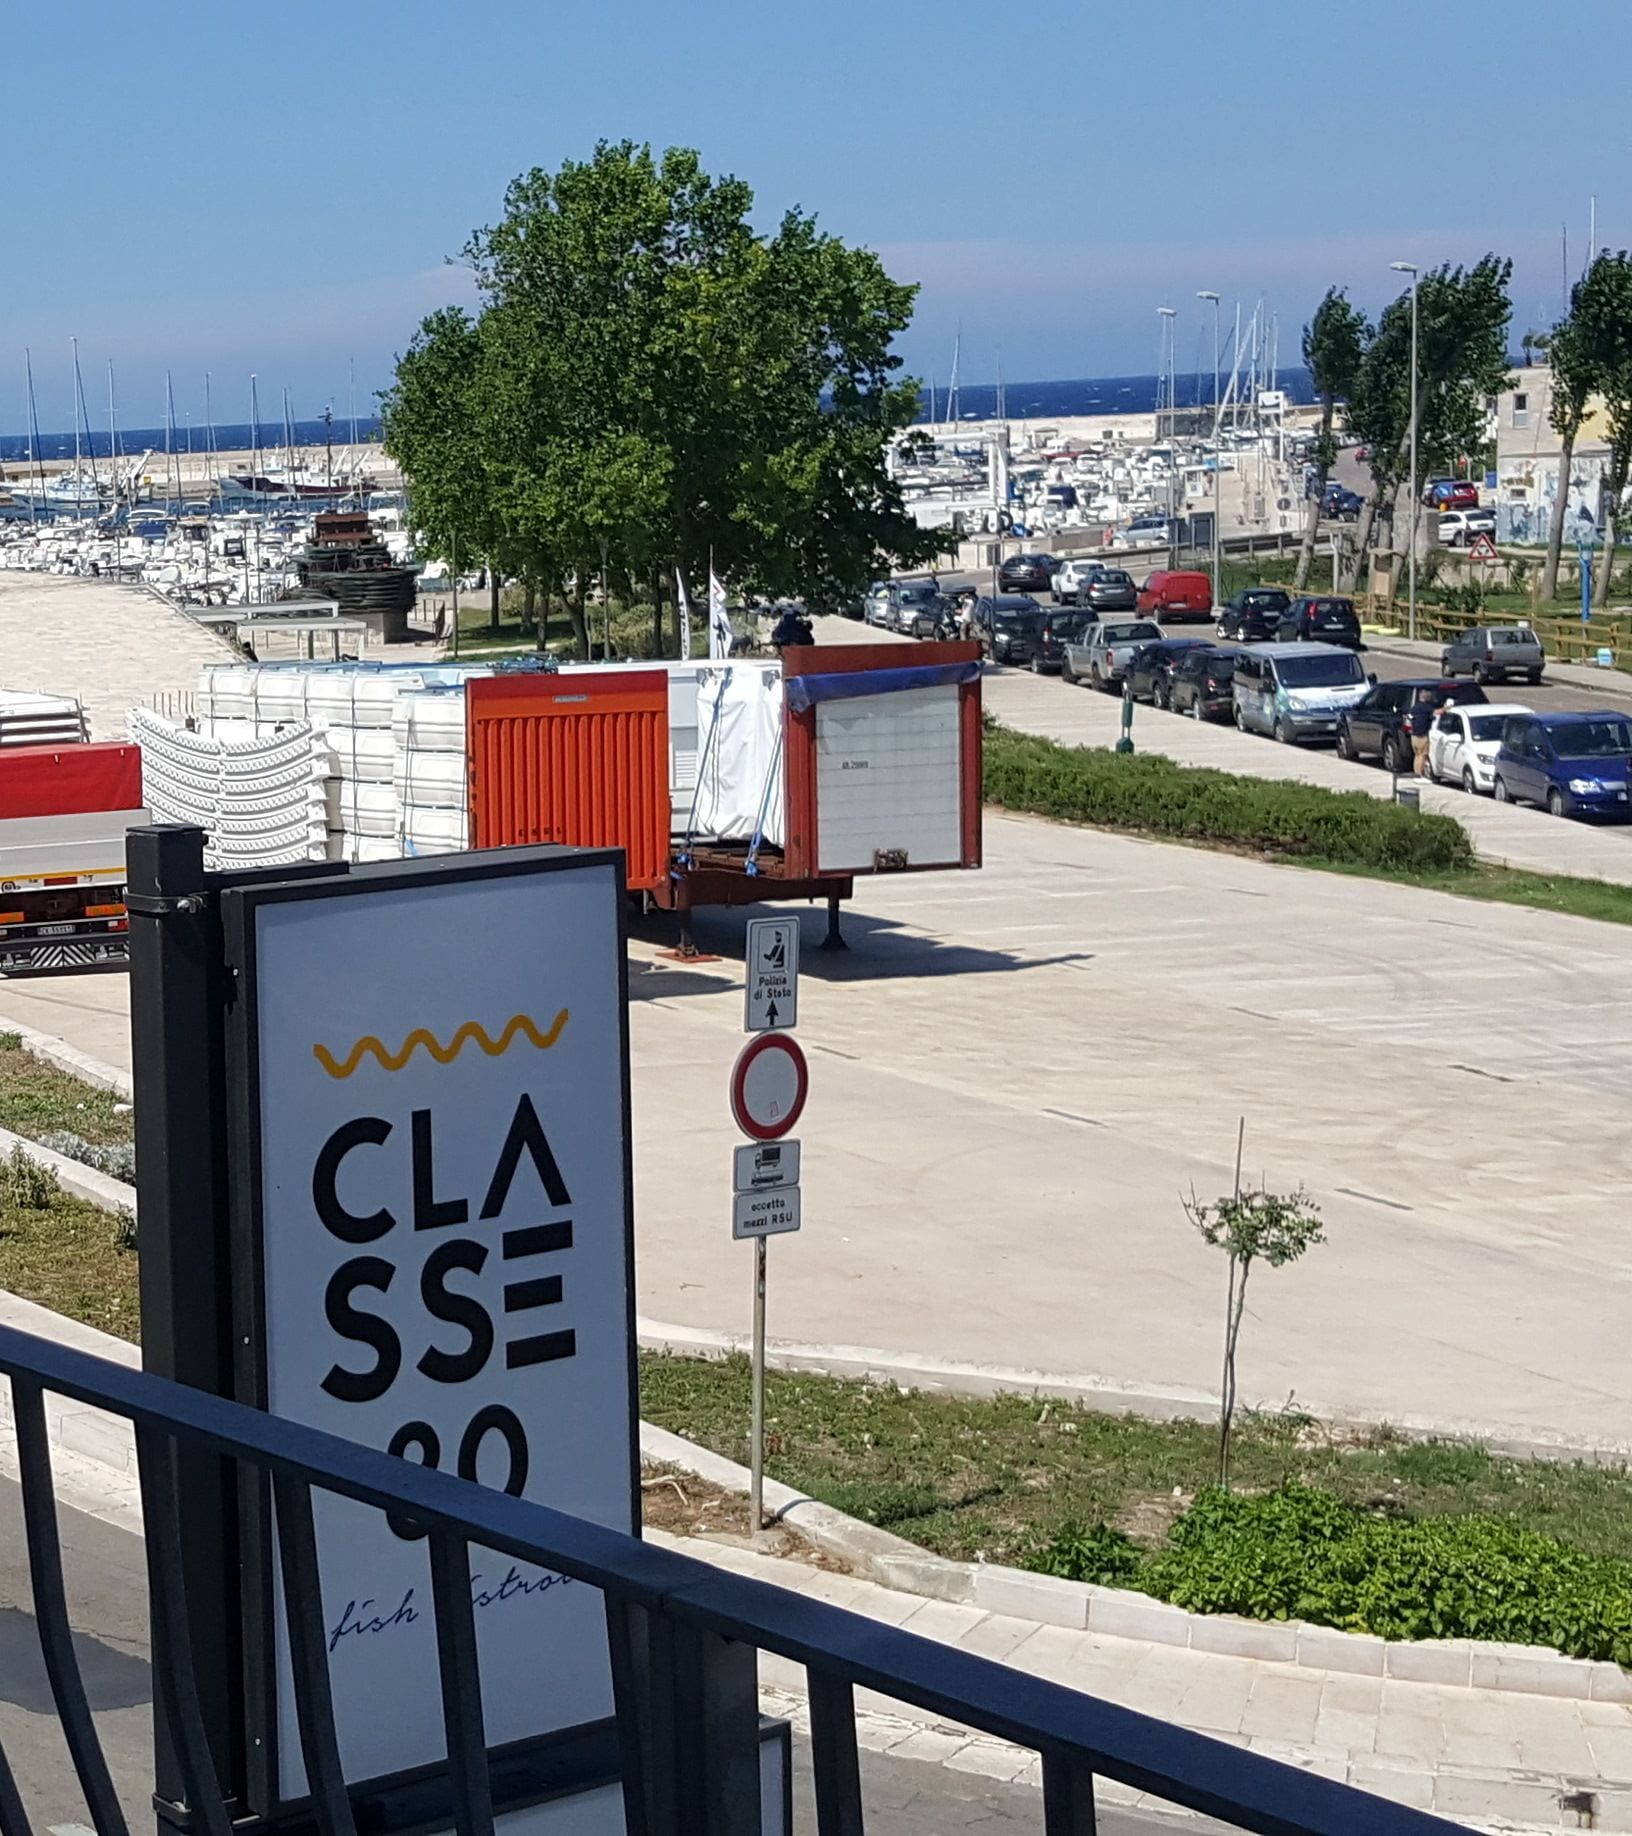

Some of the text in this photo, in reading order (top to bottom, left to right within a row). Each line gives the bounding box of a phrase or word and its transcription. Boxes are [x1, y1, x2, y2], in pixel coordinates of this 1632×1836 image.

[754, 987, 792, 1000] di Stato
[758, 975, 787, 987] Polizia
[312, 1092, 573, 1244] CLA
[771, 1210, 793, 1225] RSU
[319, 1219, 577, 1403] SSE
[328, 1587, 420, 1652] fish
